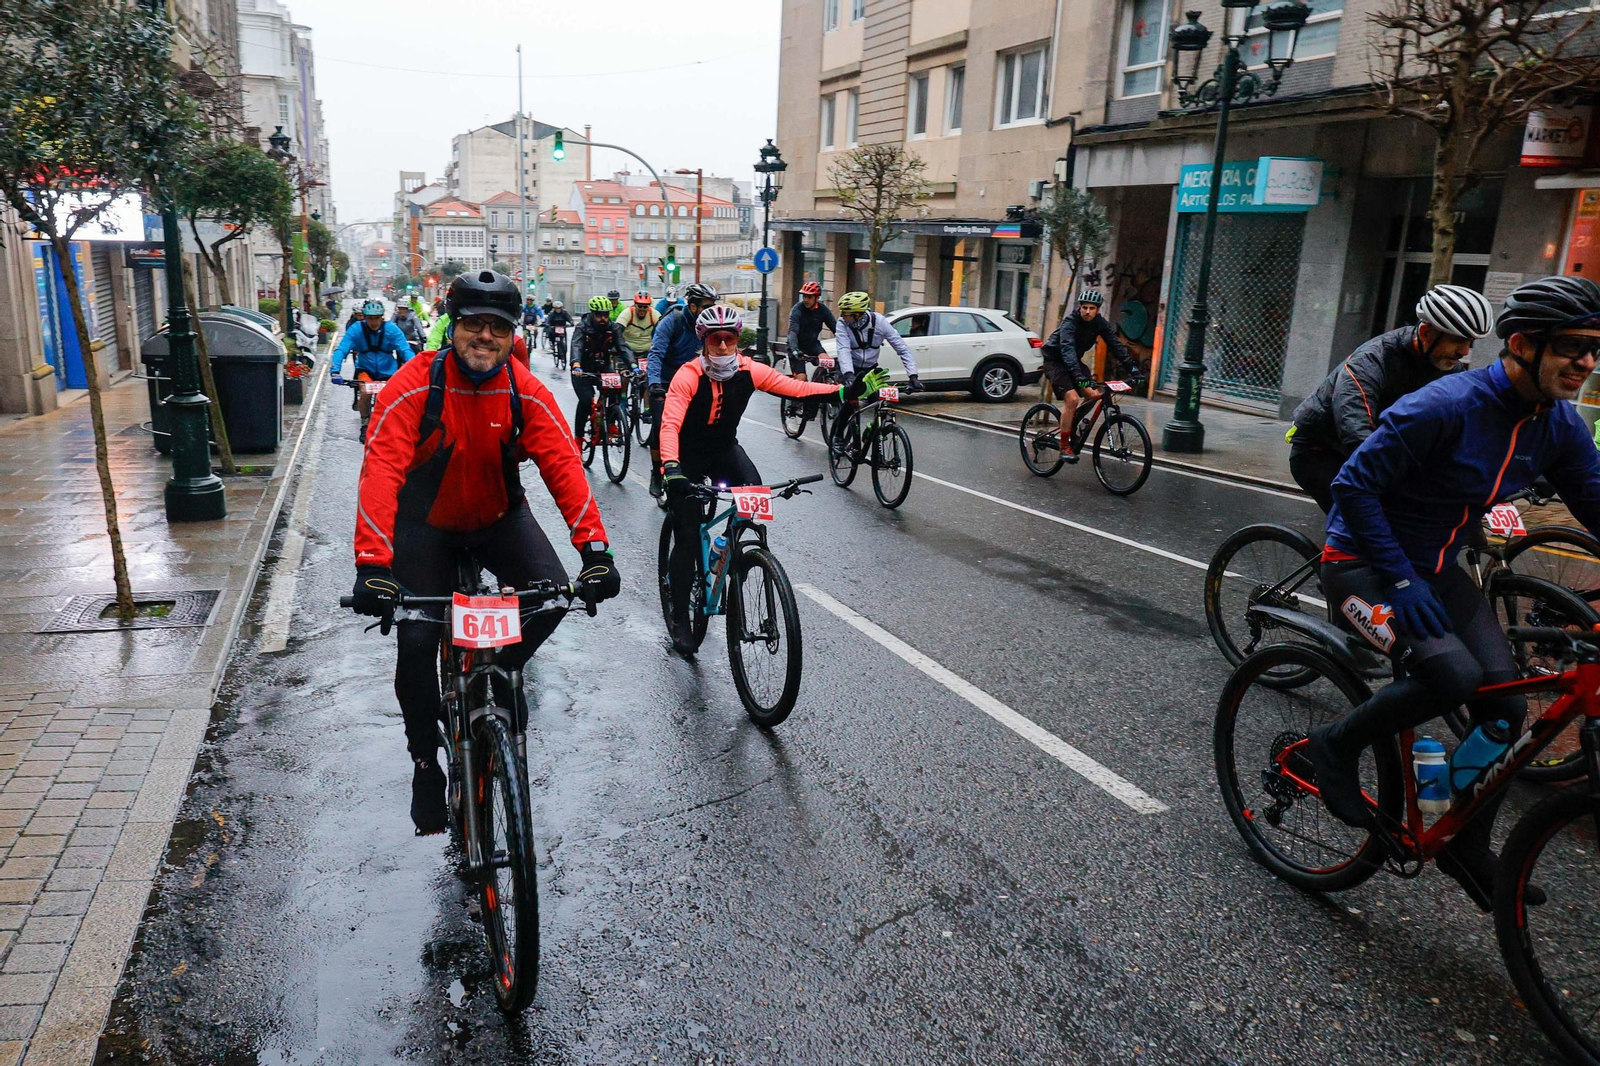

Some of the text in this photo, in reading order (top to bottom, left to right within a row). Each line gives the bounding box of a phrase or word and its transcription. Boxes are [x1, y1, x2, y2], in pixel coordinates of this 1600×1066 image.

[1526, 125, 1570, 144] MARKET
[1182, 165, 1242, 188] MERCRÍA
[1180, 192, 1236, 207] ARTICLOS
[739, 496, 770, 514] 639
[1491, 509, 1519, 528] 350
[463, 613, 509, 639] 641
[1353, 610, 1388, 647] Michel
